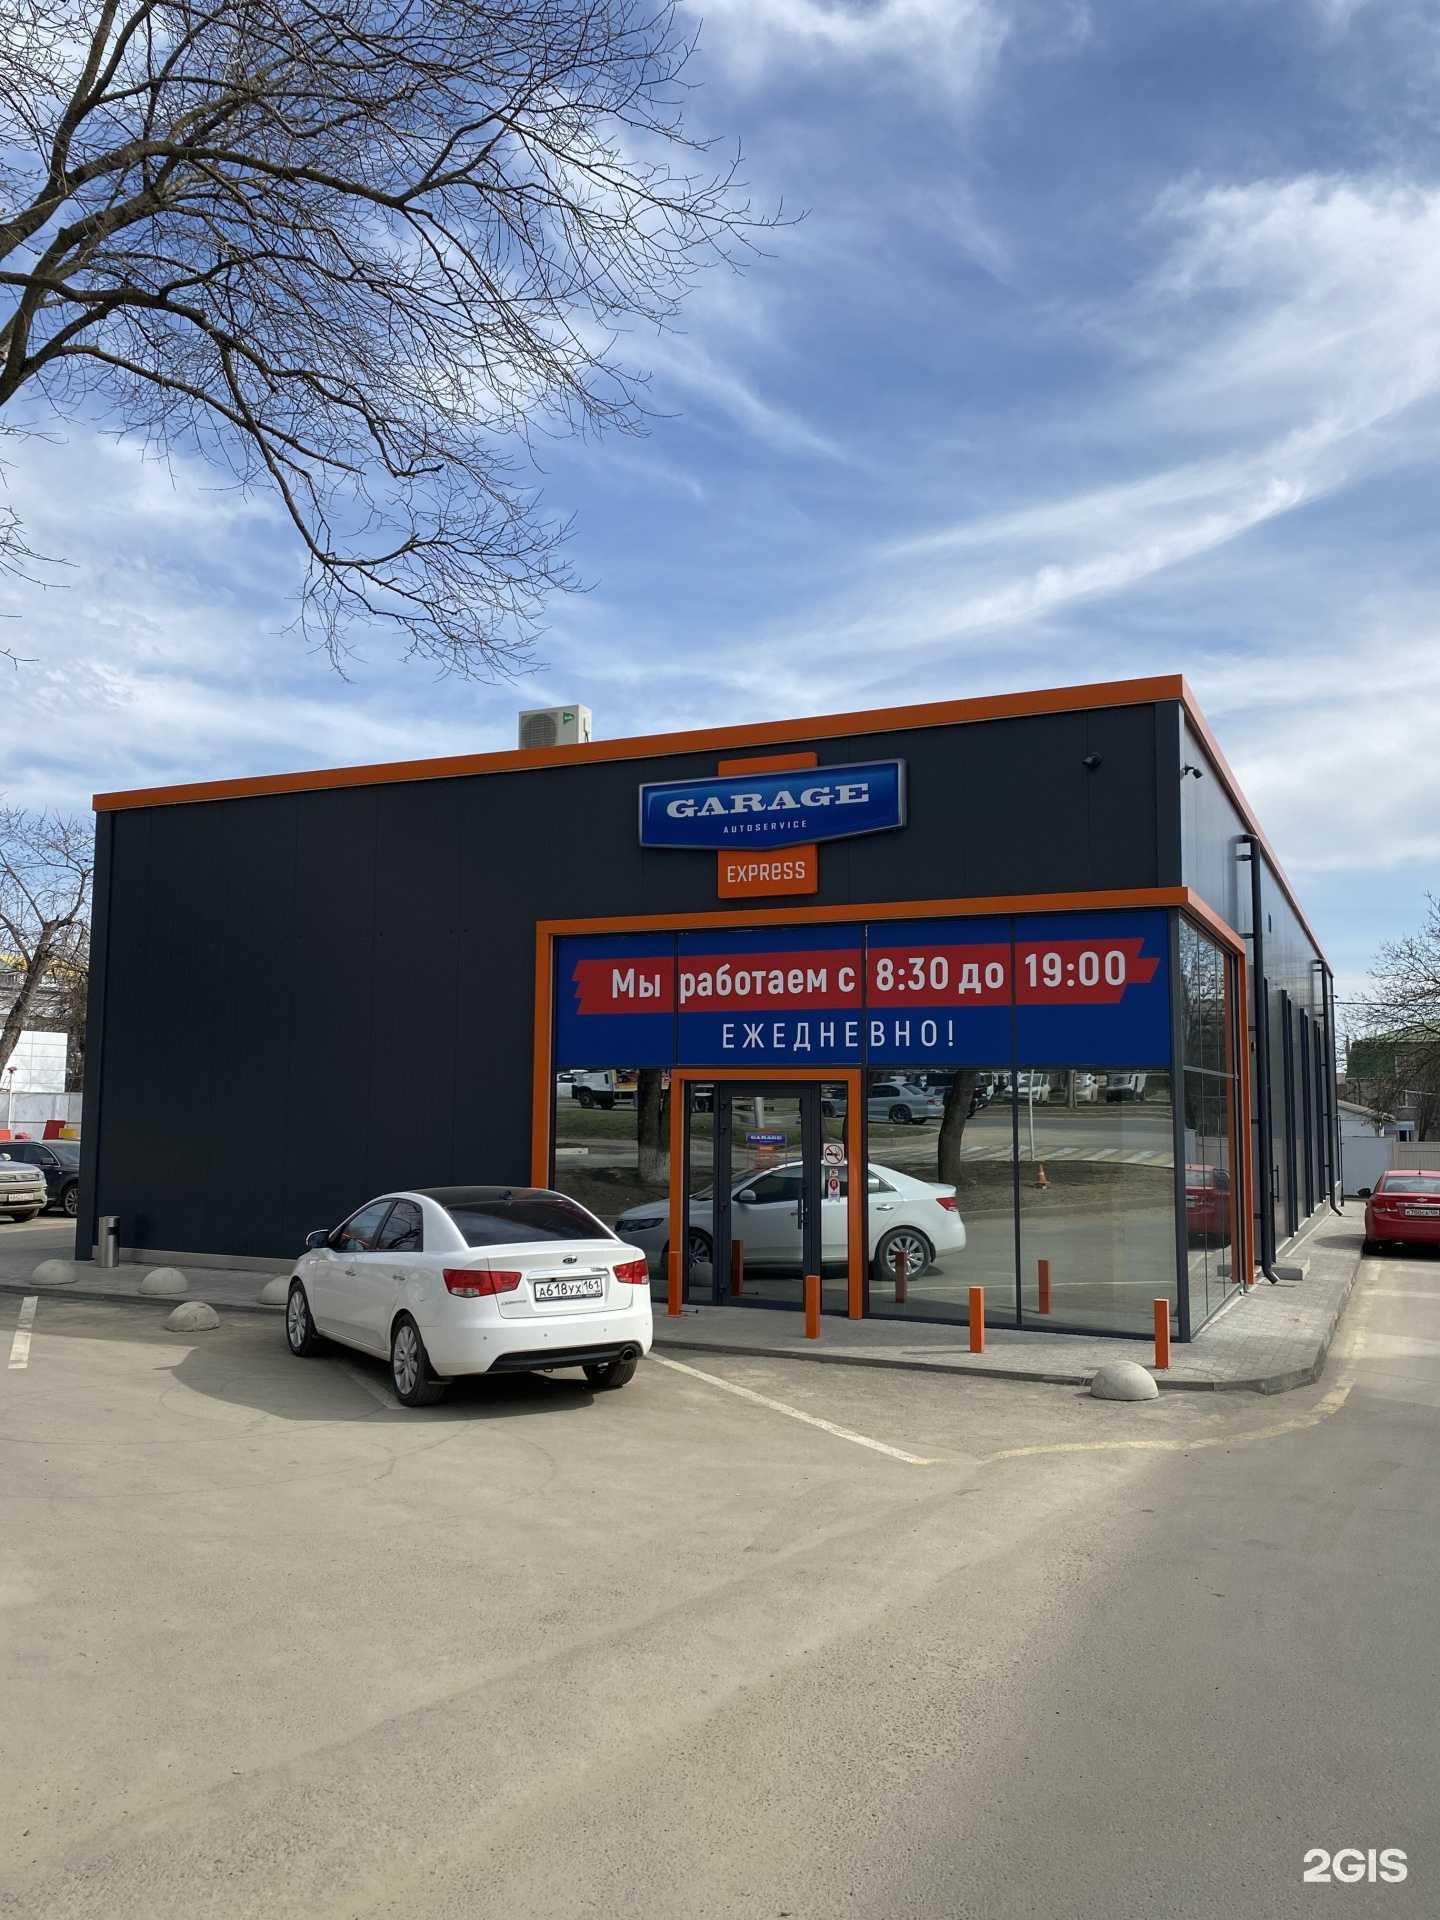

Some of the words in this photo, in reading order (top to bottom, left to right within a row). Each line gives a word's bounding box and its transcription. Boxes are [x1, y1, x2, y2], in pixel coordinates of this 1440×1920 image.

[666, 783, 870, 818] GARAGE
[723, 820, 808, 834] AUTOSERVICE
[611, 968, 661, 998] Мы
[680, 963, 828, 1004] работаем
[838, 966, 856, 993] с
[876, 956, 949, 991] 8:30
[958, 962, 1004, 994] до
[1025, 950, 1126, 987] 19:00
[722, 1018, 954, 1051] ЕЖЕДНЕВНО!
